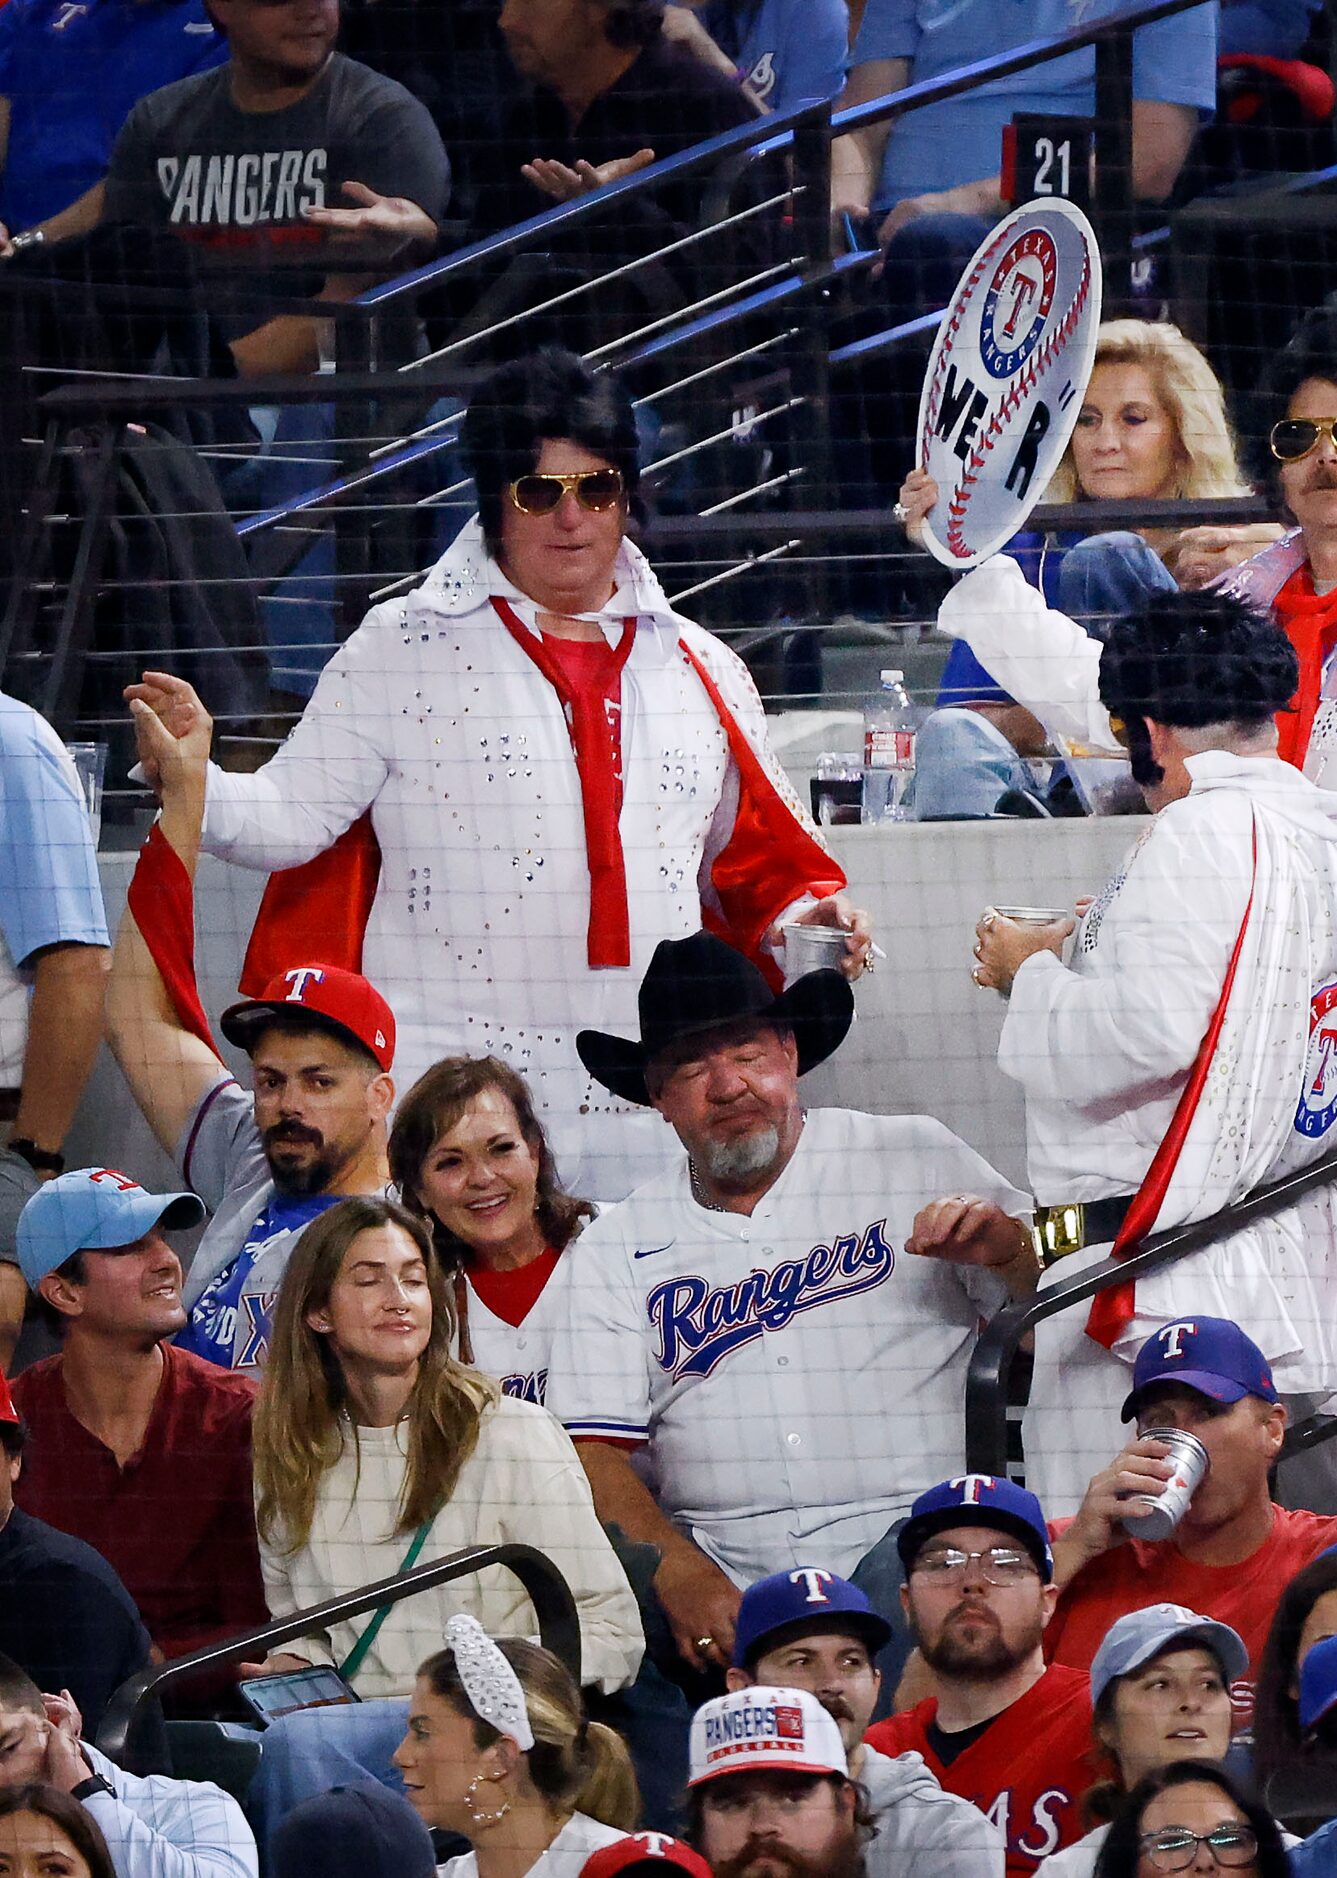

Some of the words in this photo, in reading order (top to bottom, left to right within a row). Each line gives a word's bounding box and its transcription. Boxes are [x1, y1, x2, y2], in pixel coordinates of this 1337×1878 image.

[1034, 137, 1070, 196] 21
[1010, 237, 1054, 283] TEXAS
[1010, 271, 1038, 340] T
[983, 304, 1038, 372] RANGERS
[935, 364, 989, 461] WE
[1004, 400, 1050, 500] R
[285, 968, 323, 1000] T
[89, 1169, 140, 1191] T
[647, 1218, 895, 1382] Rangers
[1158, 1323, 1198, 1359] T
[949, 1474, 996, 1505] T
[789, 1568, 832, 1604] T
[705, 1707, 776, 1748] RANGERS
[633, 1831, 675, 1857] T
[985, 1790, 1069, 1856] AS
